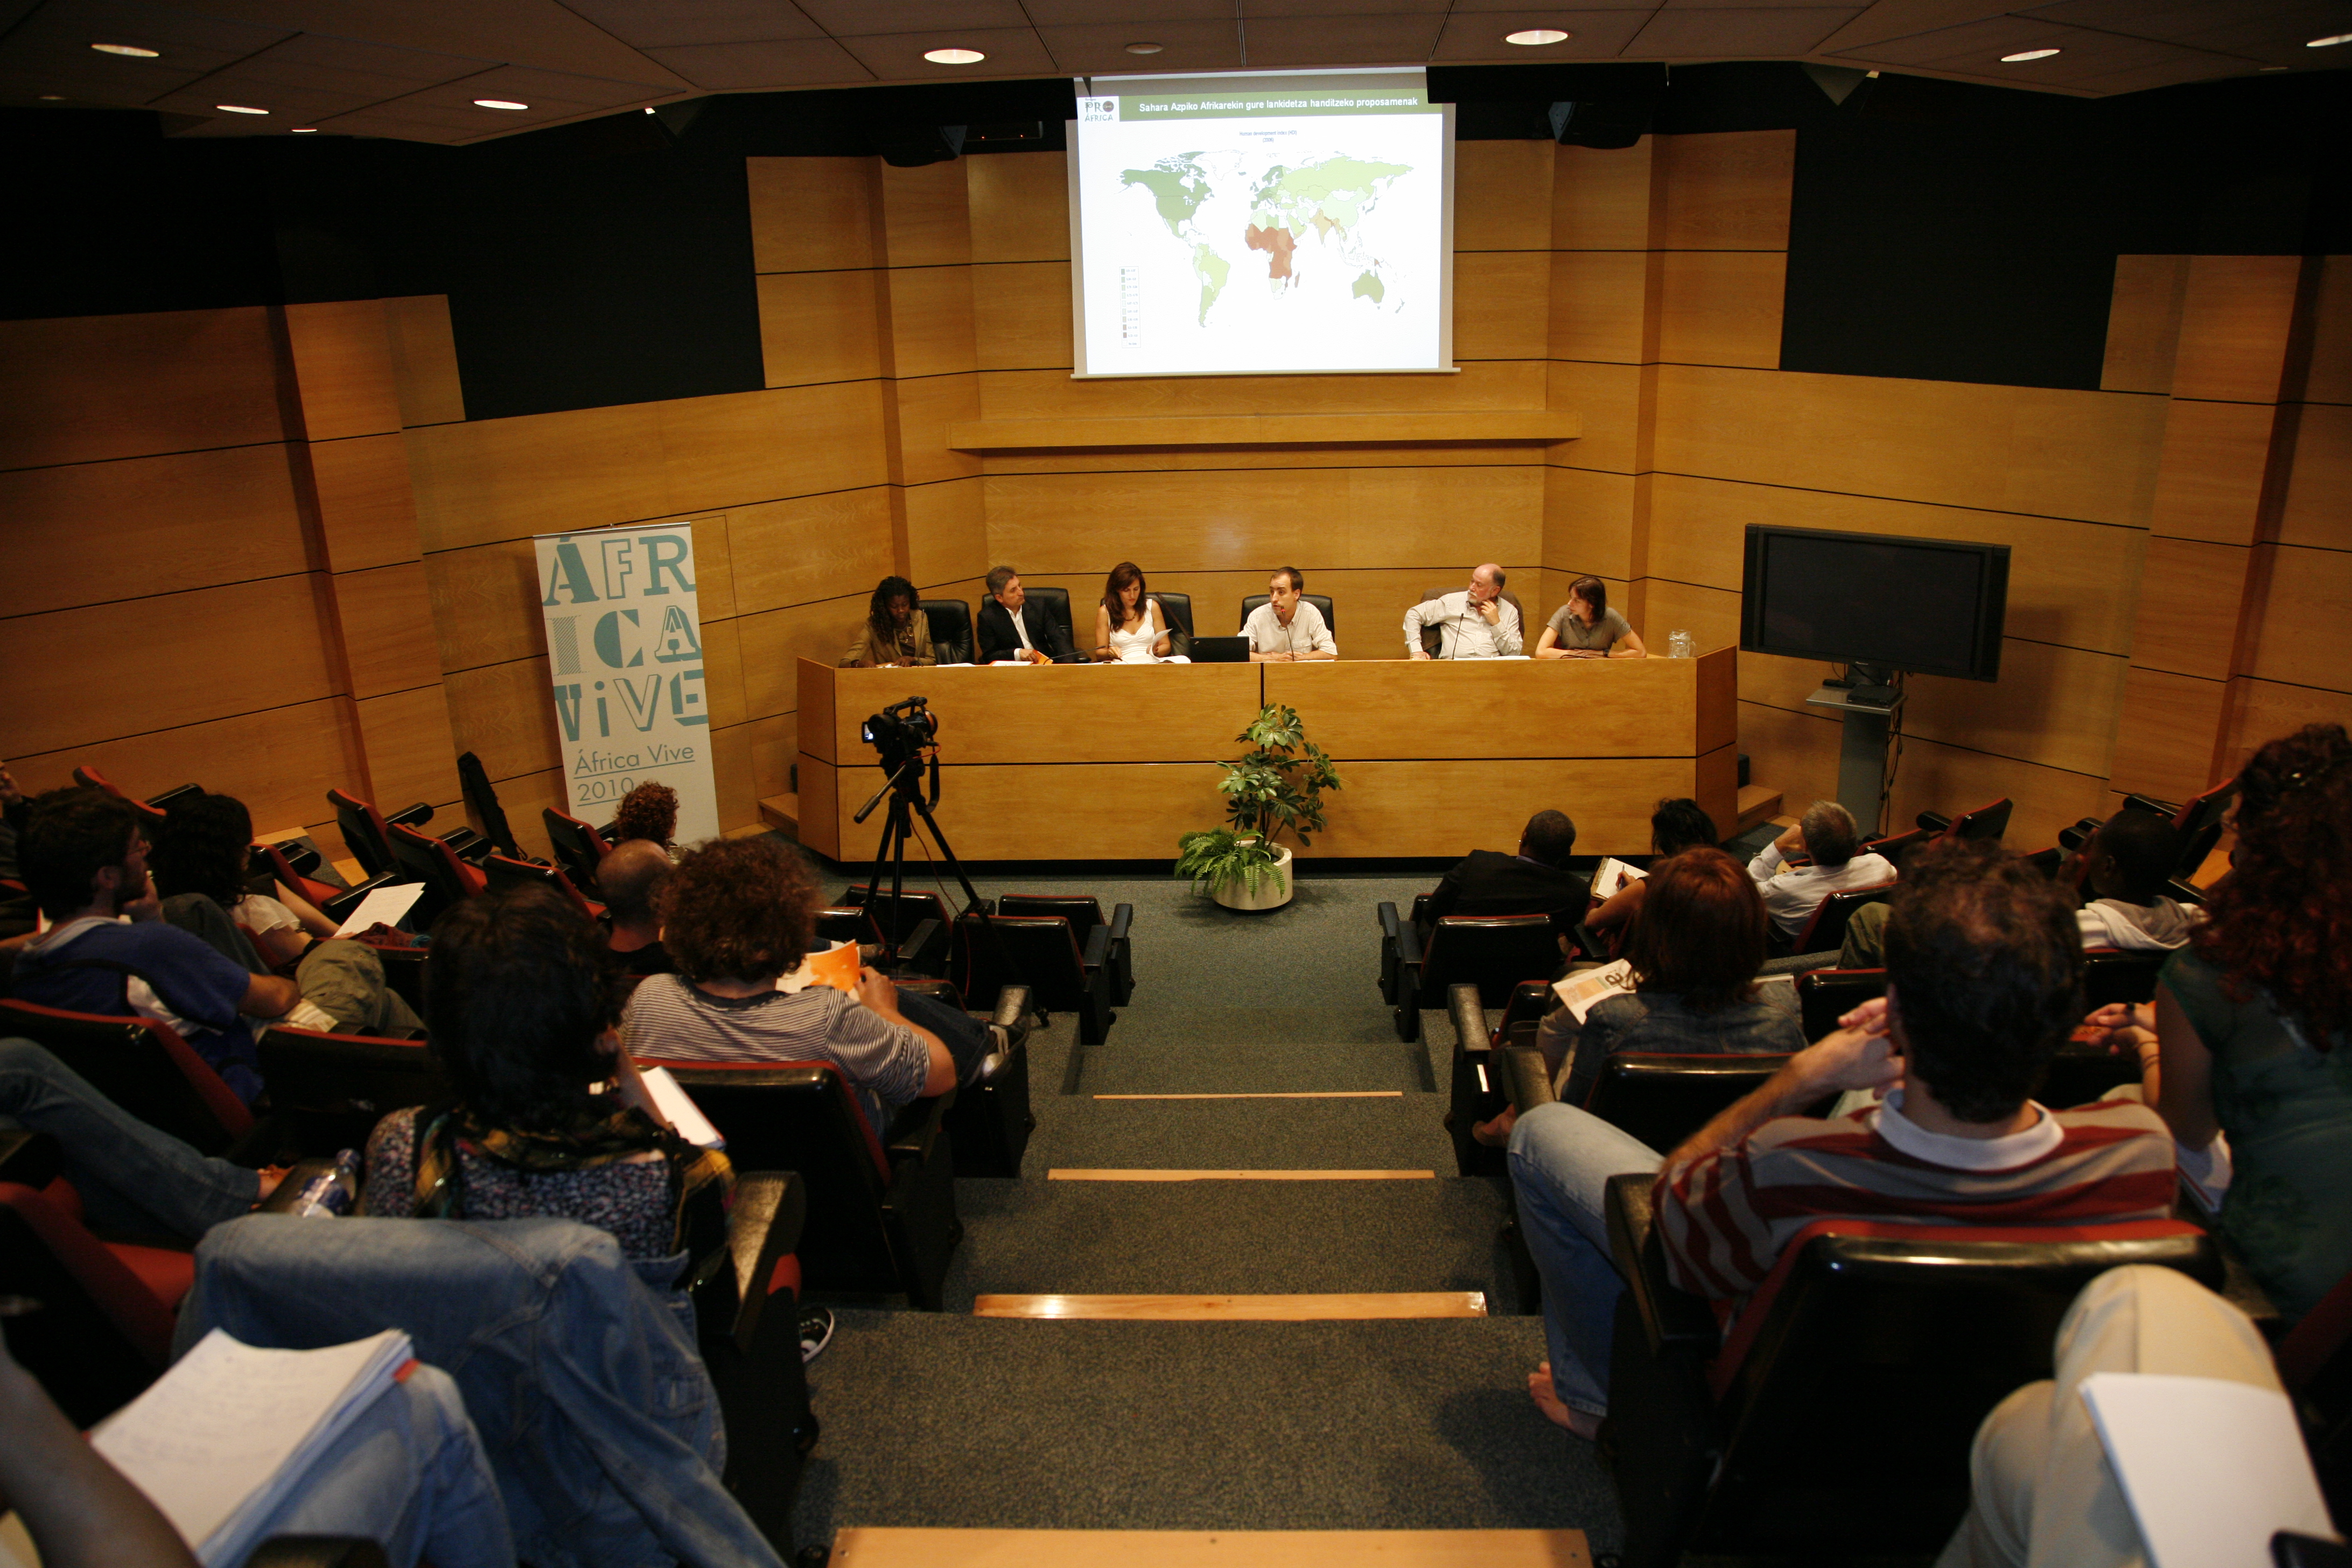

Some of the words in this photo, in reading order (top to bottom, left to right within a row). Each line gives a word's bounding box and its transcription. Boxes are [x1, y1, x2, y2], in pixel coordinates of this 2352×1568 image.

[1139, 103, 1168, 112] Sahara
[1171, 102, 1198, 112] Azpiko
[1200, 101, 1243, 110] Afrikarekin
[1245, 101, 1264, 111] gure
[1266, 99, 1307, 108] lankidetza
[1310, 98, 1354, 107] handitzeko
[1356, 97, 1418, 108] proposamenak
[575, 749, 640, 774] África
[647, 744, 694, 764] Vive
[577, 777, 634, 801] 2010
